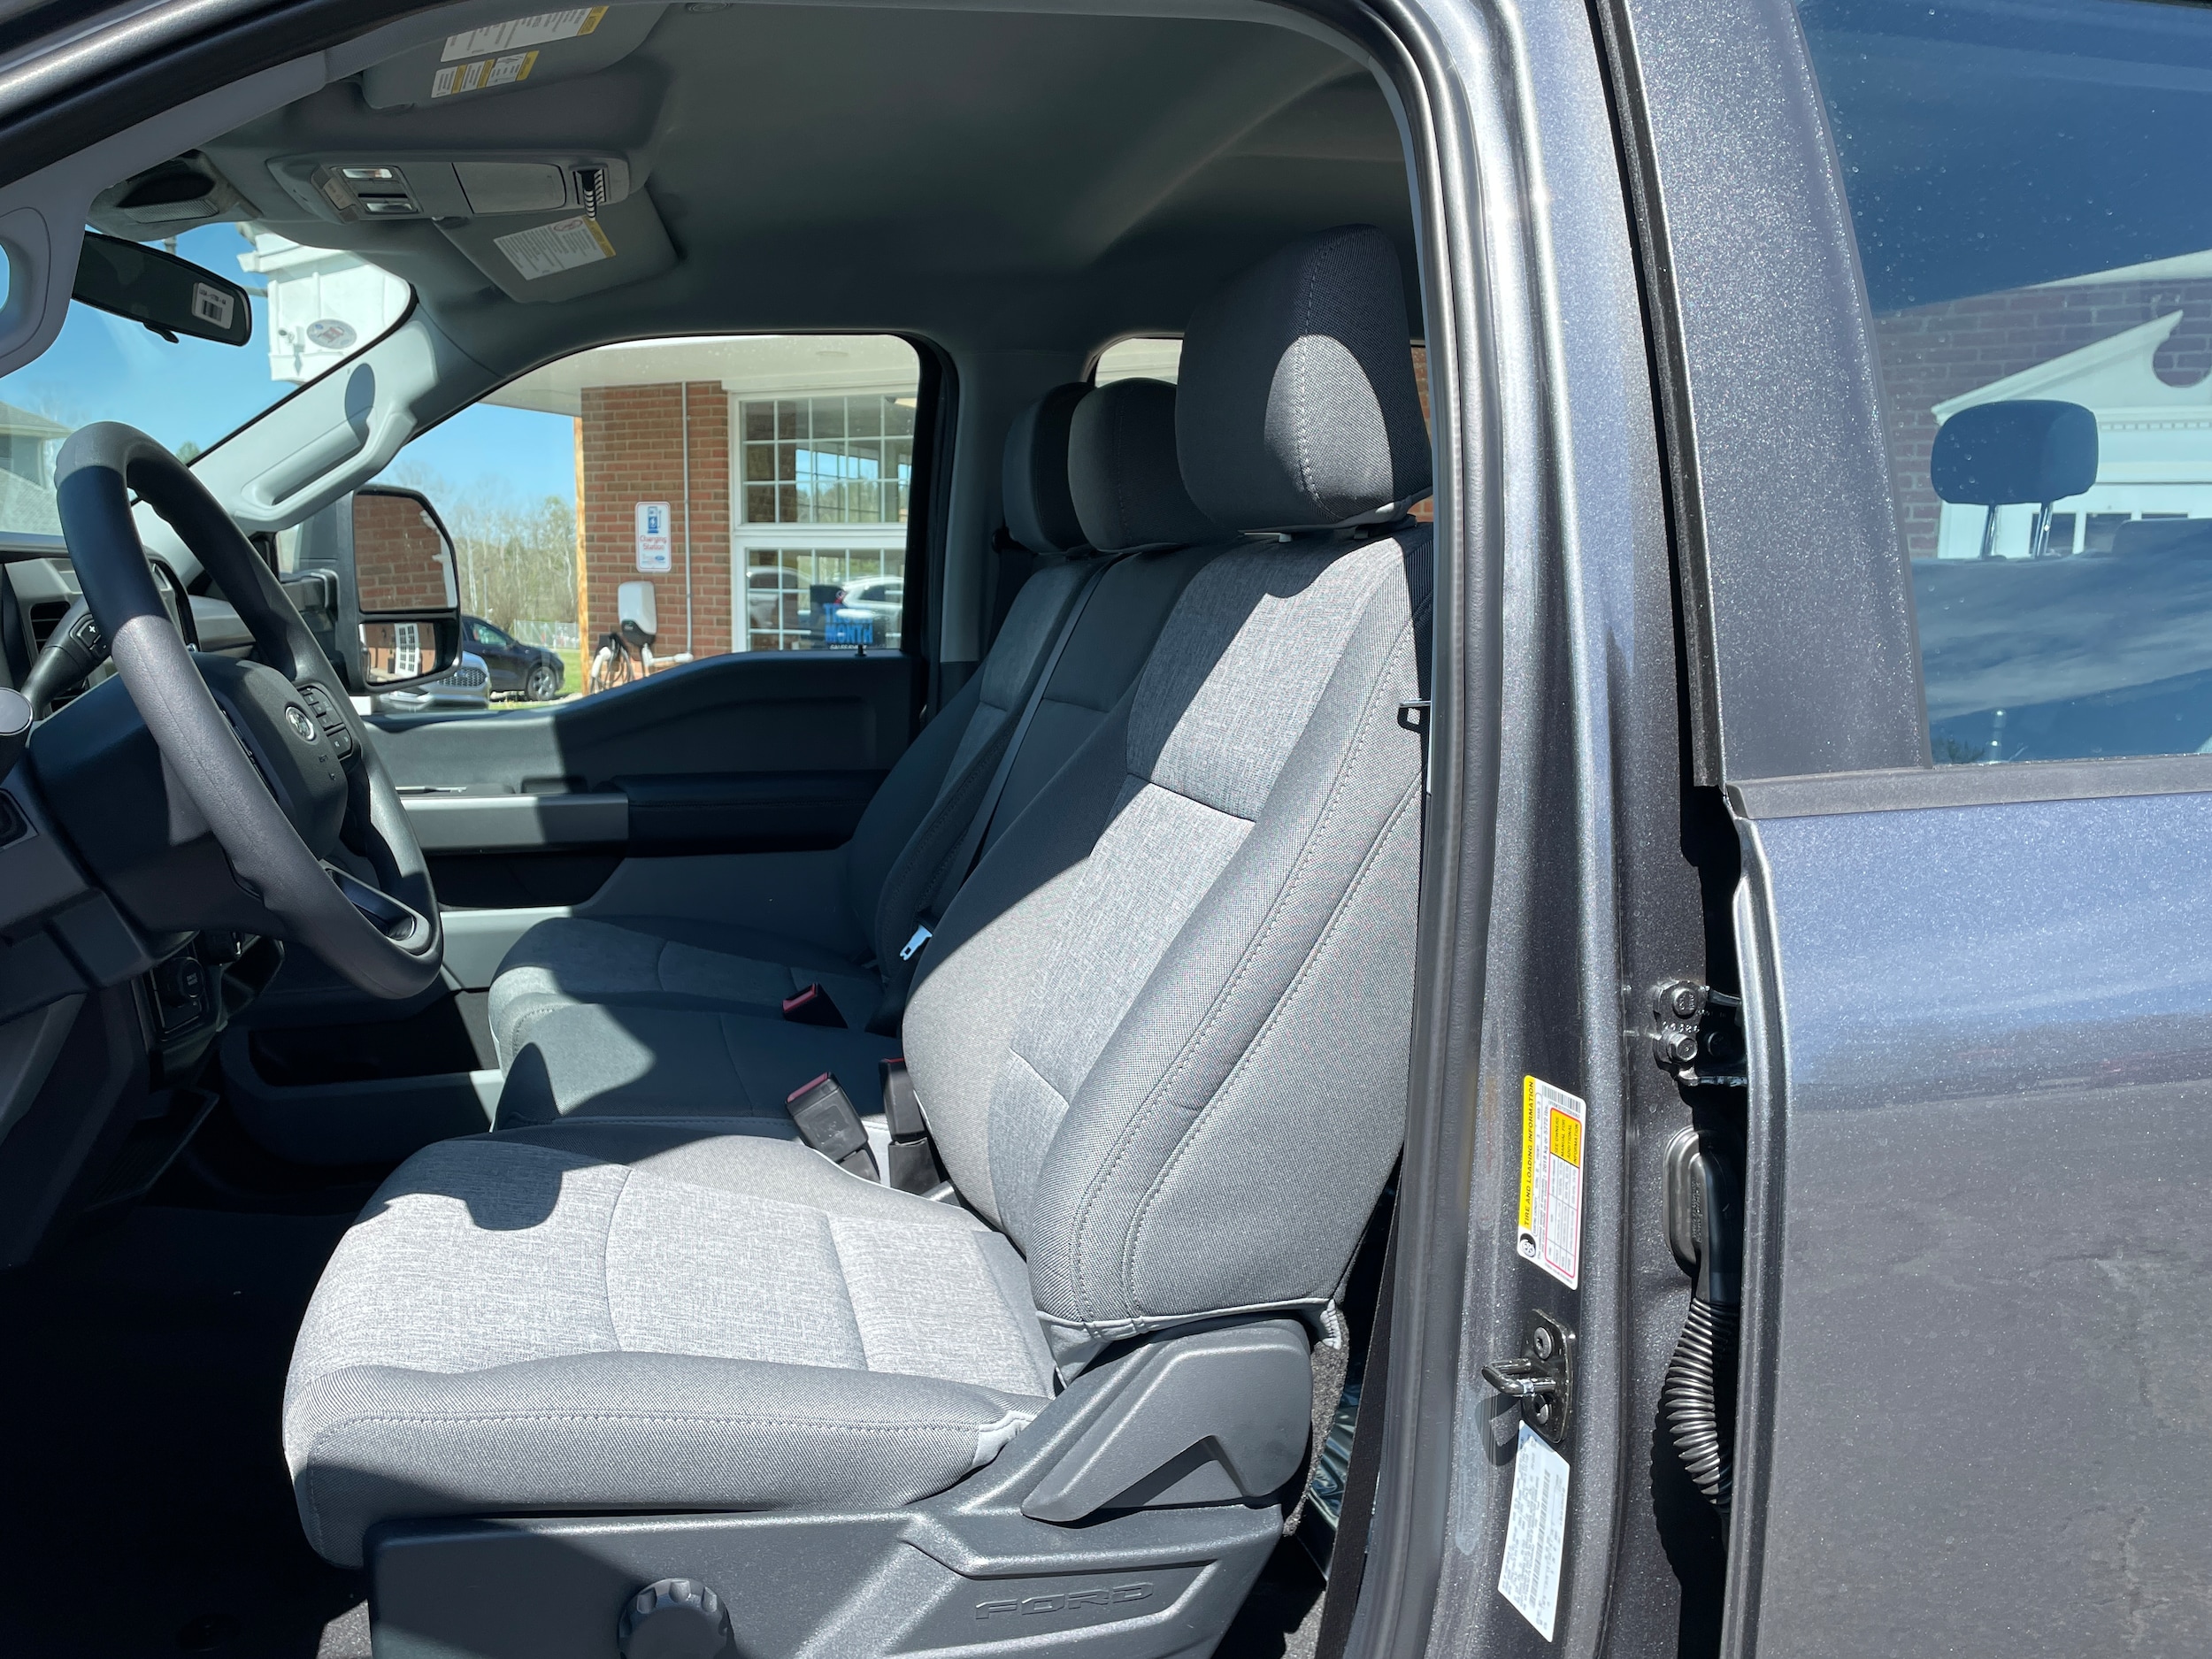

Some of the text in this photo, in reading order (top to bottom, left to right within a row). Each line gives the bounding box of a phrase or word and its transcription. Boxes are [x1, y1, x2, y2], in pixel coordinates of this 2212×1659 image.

[825, 624, 873, 644] MONTH
[1542, 1144, 1548, 1155] kg
[975, 1582, 1154, 1620] FORD
